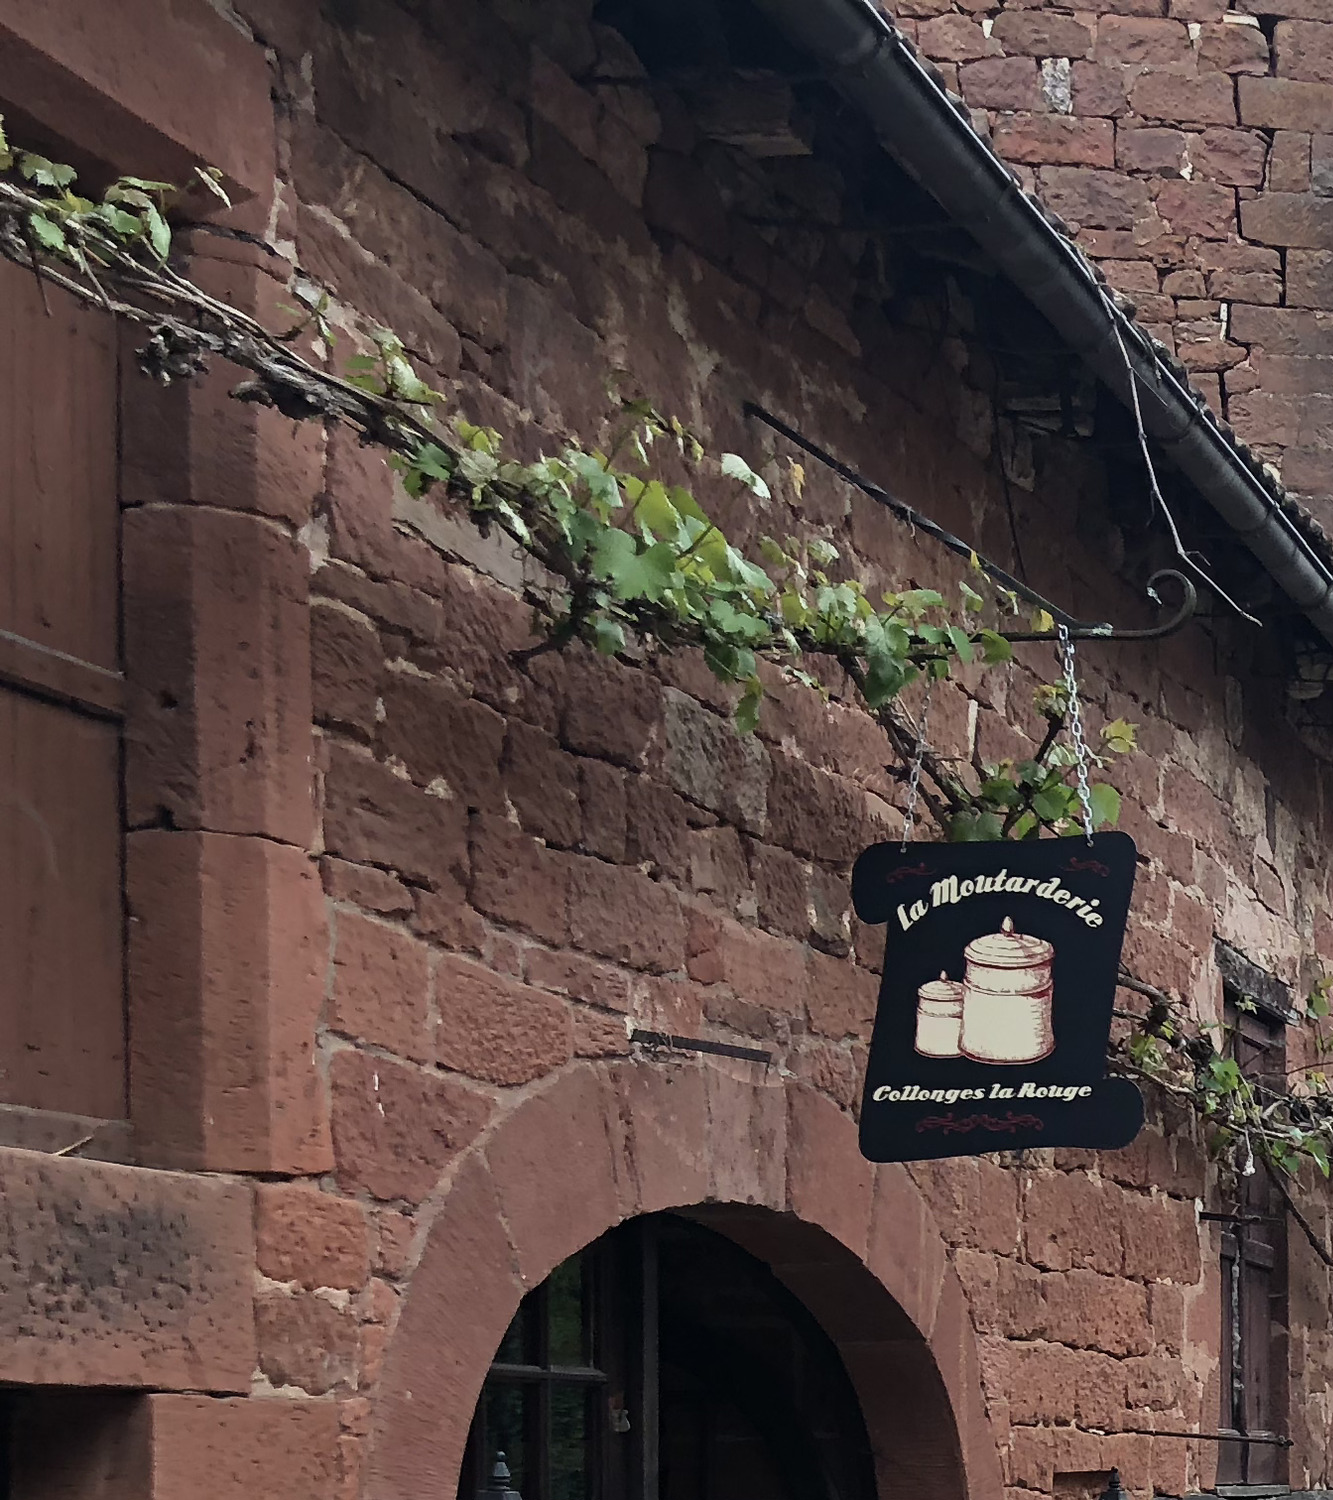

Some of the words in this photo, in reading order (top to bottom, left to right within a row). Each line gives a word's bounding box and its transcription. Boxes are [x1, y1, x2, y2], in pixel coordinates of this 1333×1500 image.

[929, 868, 1103, 928] Moutarderie
[872, 1085, 985, 1104] Collonges
[989, 1083, 1016, 1099] la
[1016, 1082, 1093, 1101] Rouge
